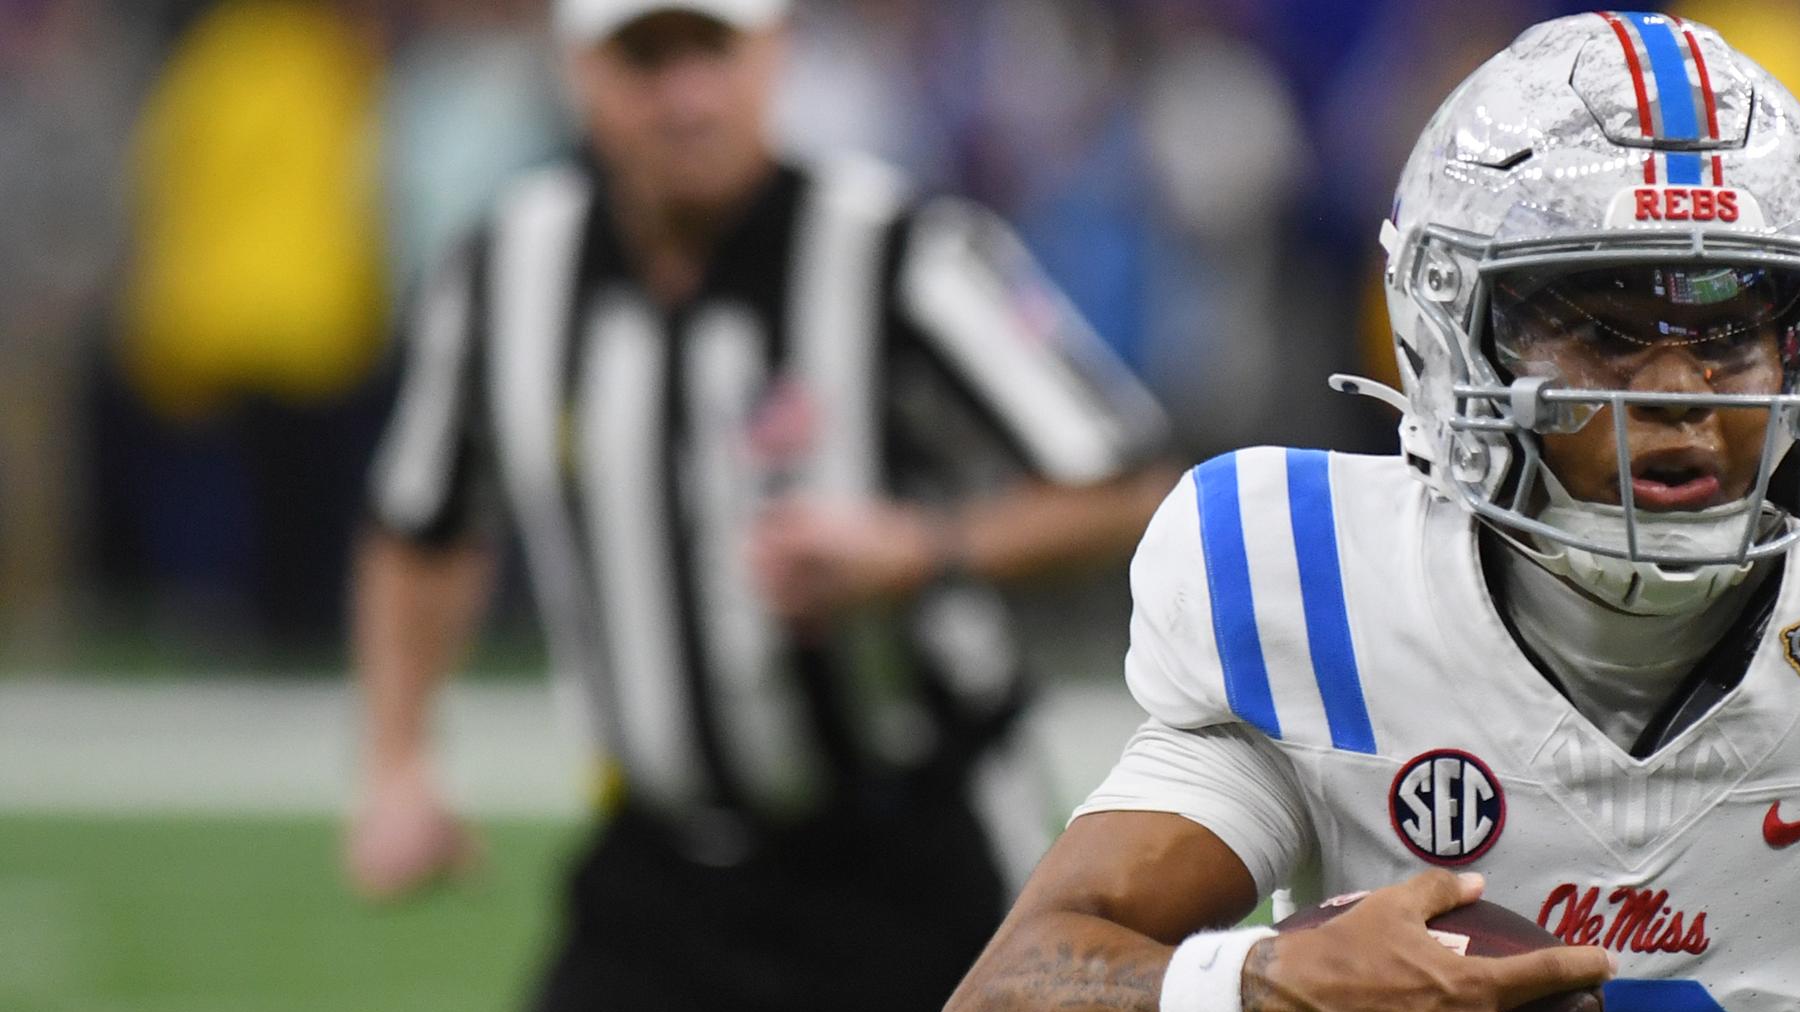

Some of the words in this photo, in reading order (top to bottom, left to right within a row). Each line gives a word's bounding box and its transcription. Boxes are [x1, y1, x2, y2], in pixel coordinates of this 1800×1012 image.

[1634, 188, 1739, 223] REBS
[1398, 757, 1495, 857] SEC
[1537, 882, 1604, 946] Ole
[1603, 886, 1711, 955] Miss
